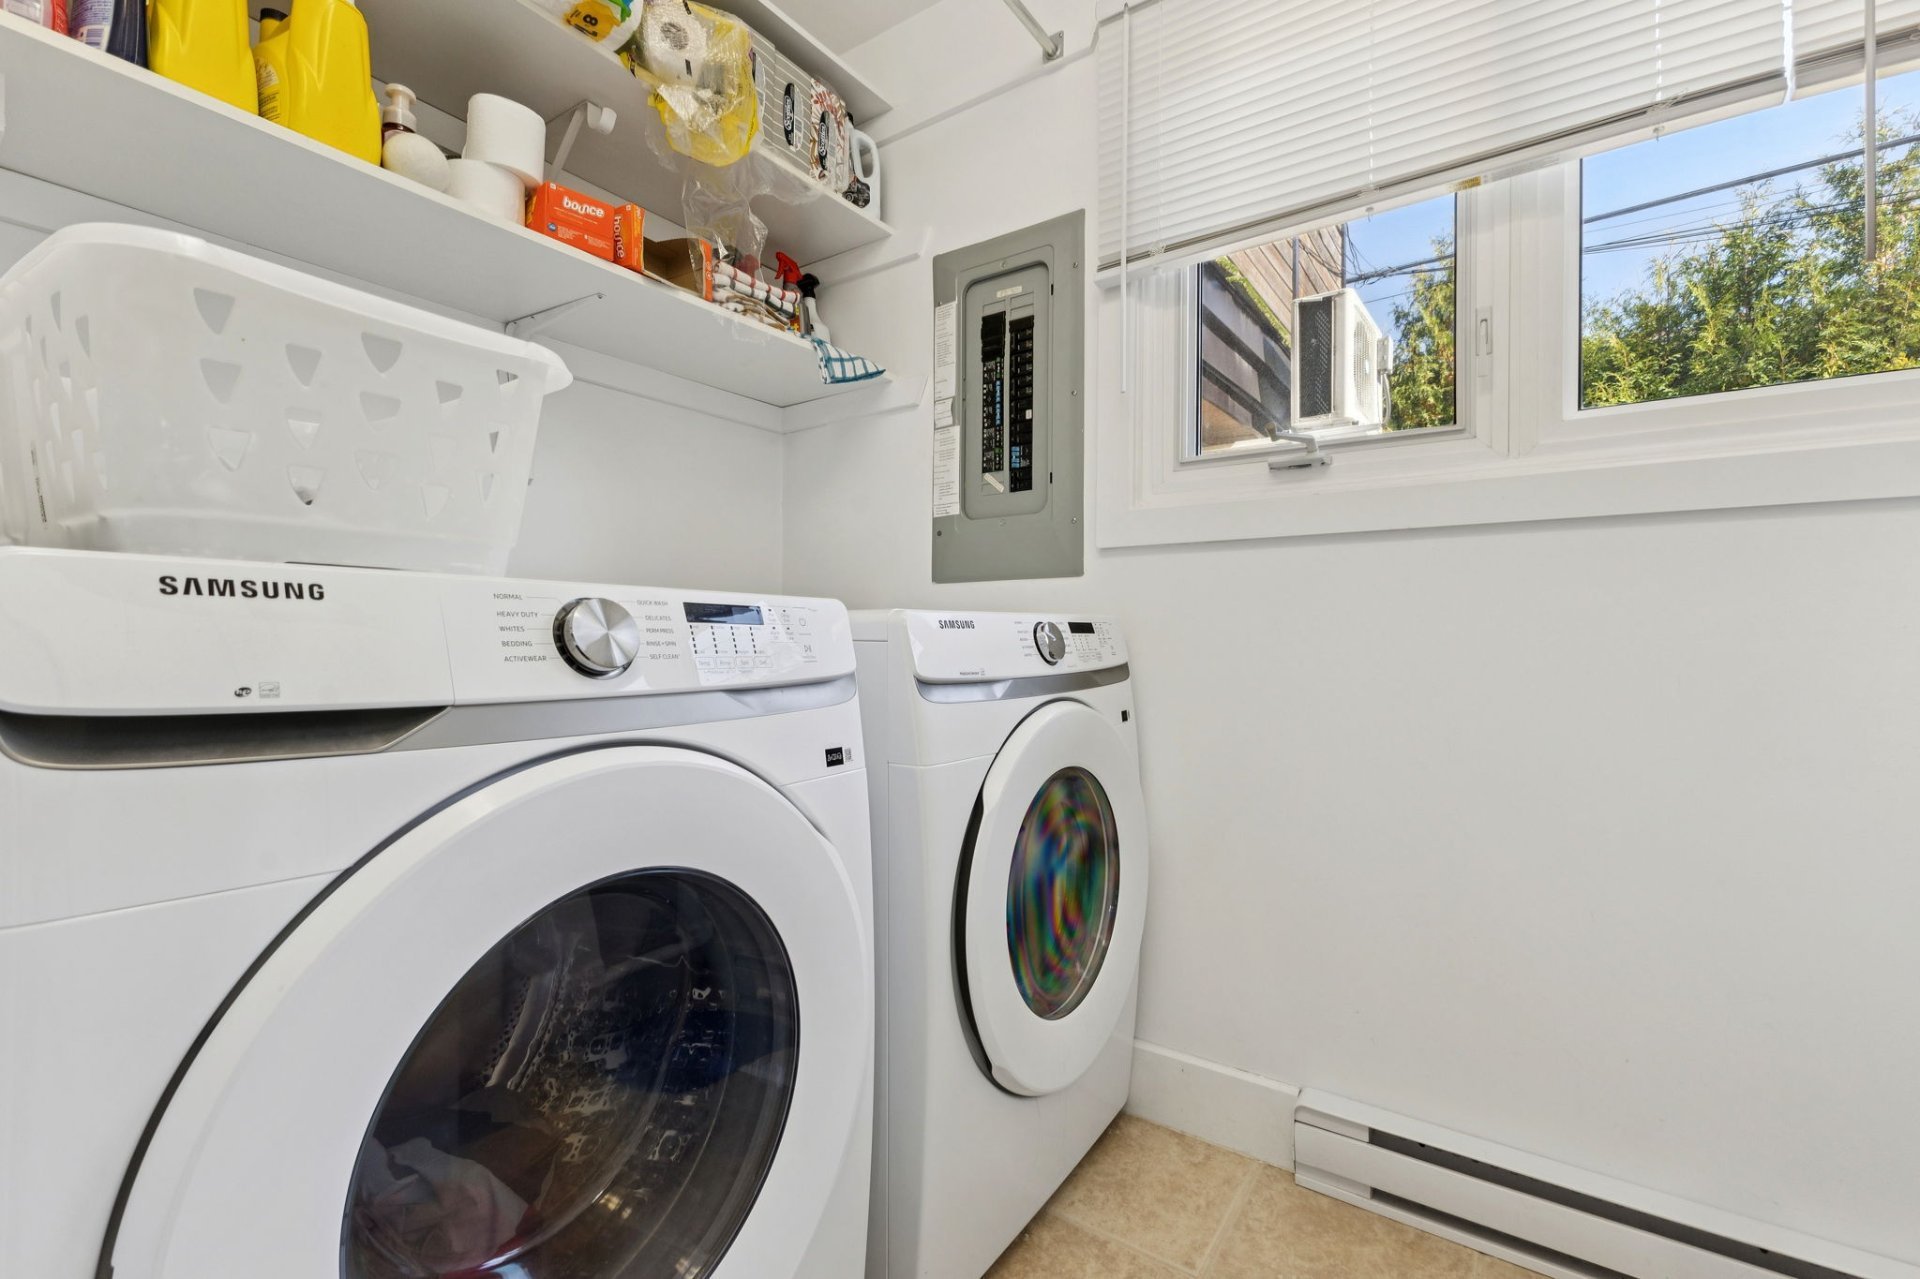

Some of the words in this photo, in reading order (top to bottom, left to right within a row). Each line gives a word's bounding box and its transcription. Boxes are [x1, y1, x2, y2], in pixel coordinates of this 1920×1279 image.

[583, 14, 599, 27] 8
[563, 195, 605, 218] bounce
[159, 576, 325, 601] SAMSUNG
[938, 619, 975, 630] SAMSUNG
